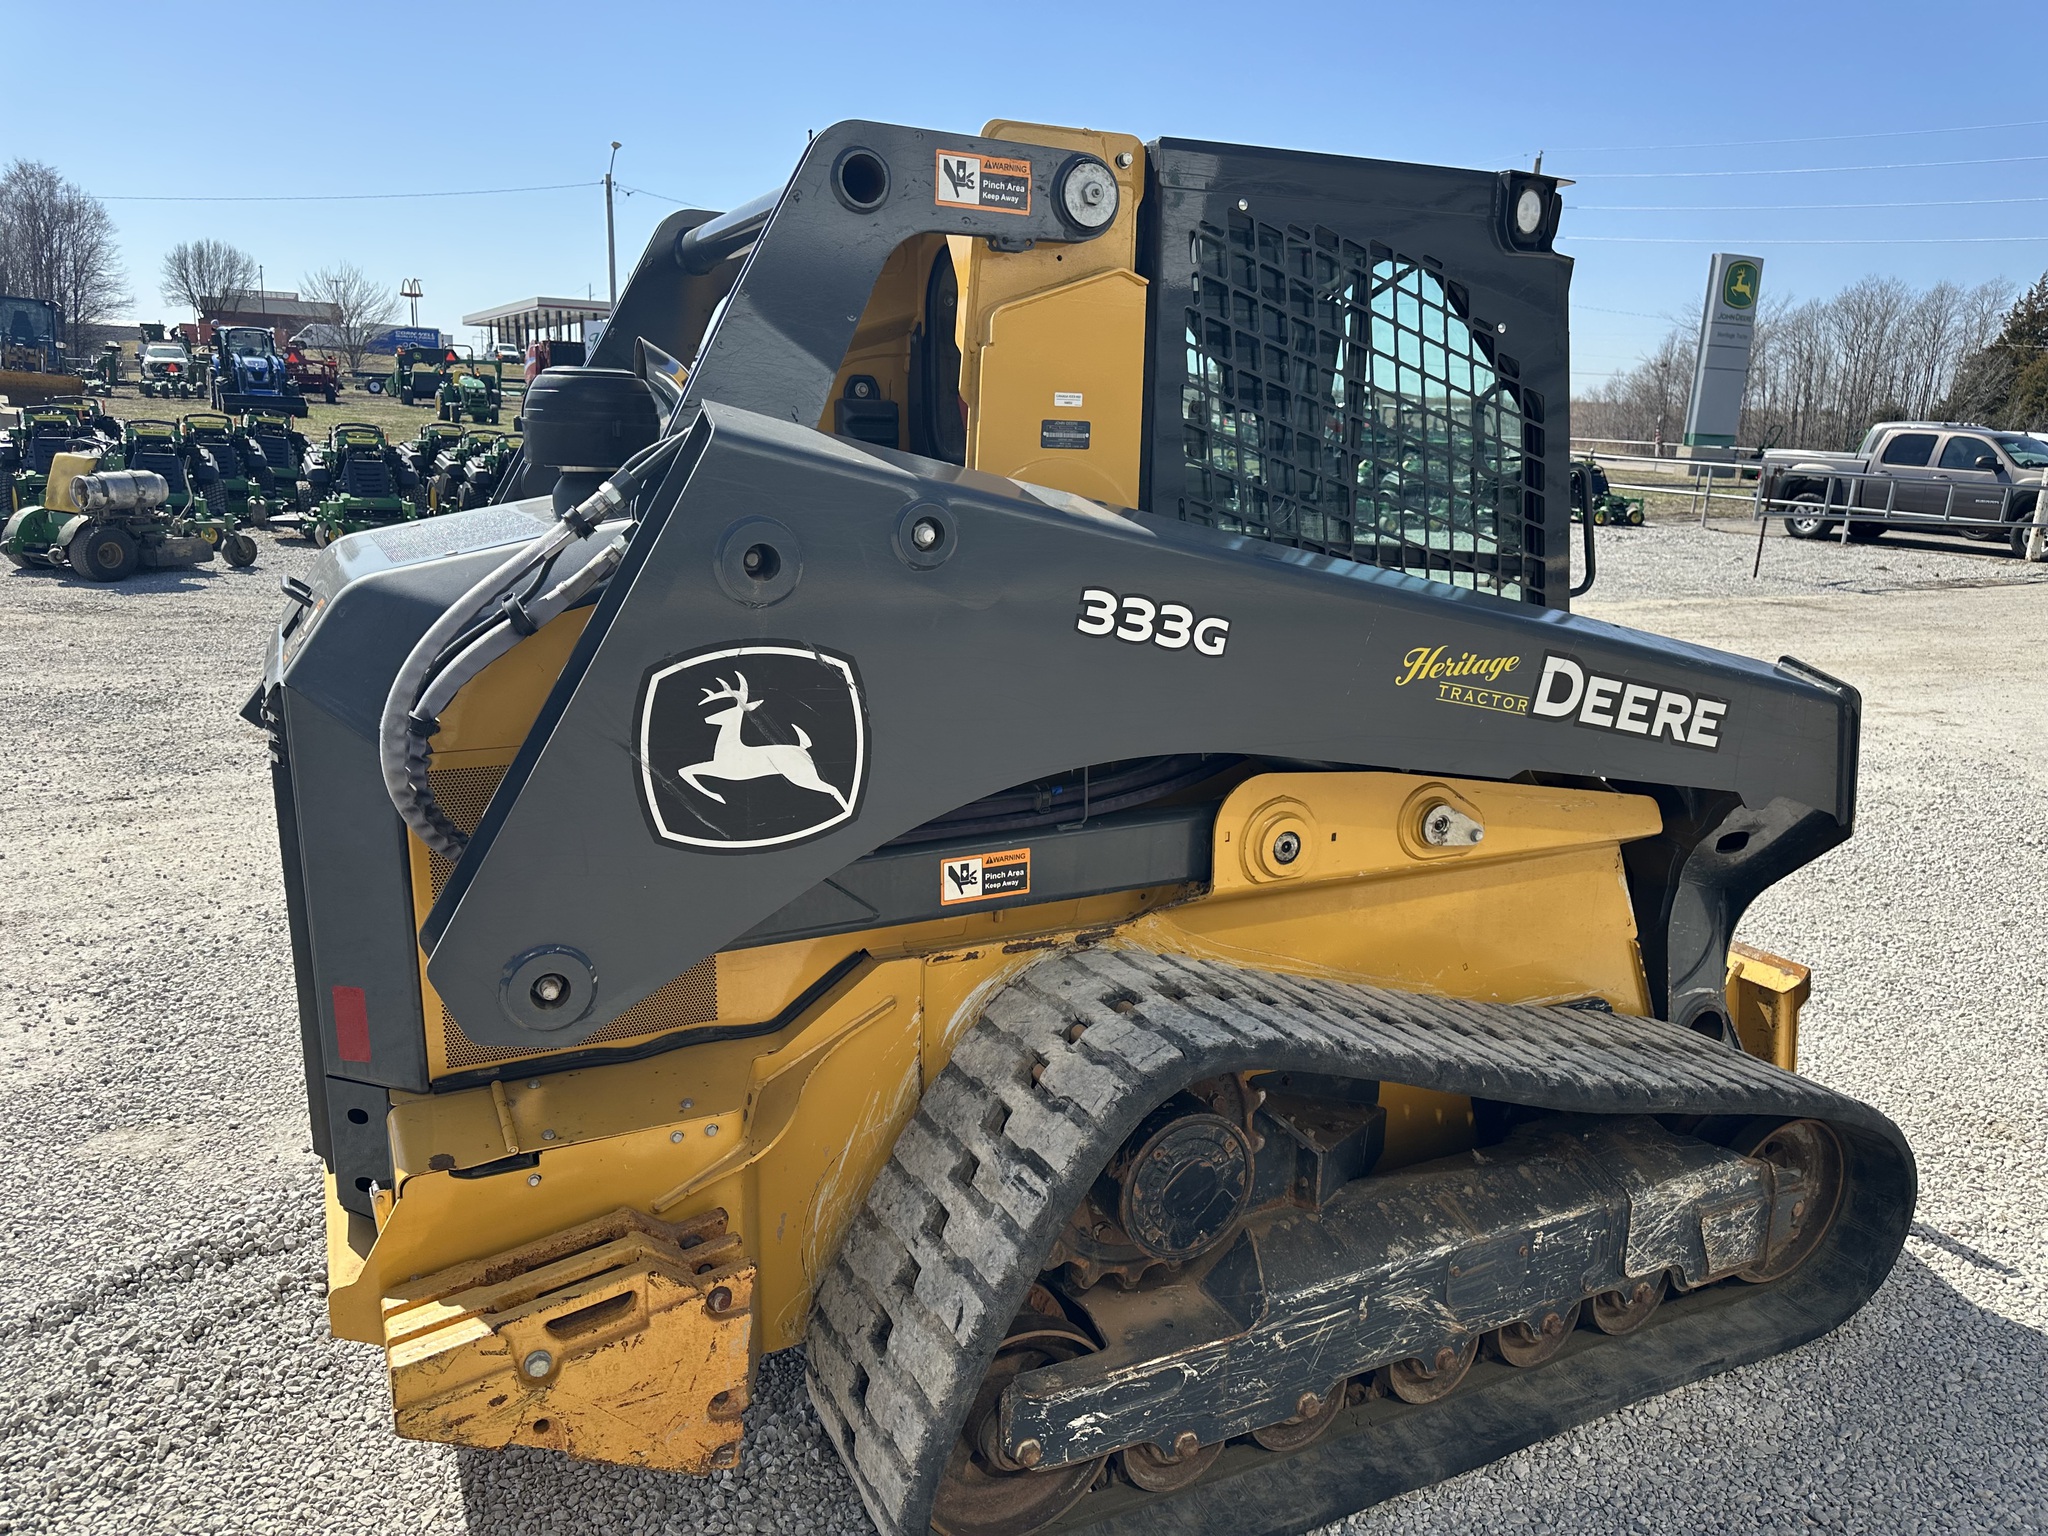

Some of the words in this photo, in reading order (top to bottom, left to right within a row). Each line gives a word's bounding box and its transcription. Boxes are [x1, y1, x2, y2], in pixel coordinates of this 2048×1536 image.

[991, 161, 1027, 173] WARNING
[982, 179, 1005, 191] Pinch
[1006, 182, 1025, 193] Area
[982, 191, 1000, 202] Keep
[1001, 194, 1019, 204] Away
[1076, 588, 1231, 657] 333G
[1395, 645, 1521, 686] Heritage
[1438, 684, 1528, 712] TRACTOR
[1532, 655, 1727, 748] DEERE
[992, 852, 1026, 864] WARNING
[984, 872, 1006, 881] Pinch
[1006, 869, 1025, 878] Area
[984, 881, 1002, 890] Keep
[1002, 879, 1019, 888] Away
